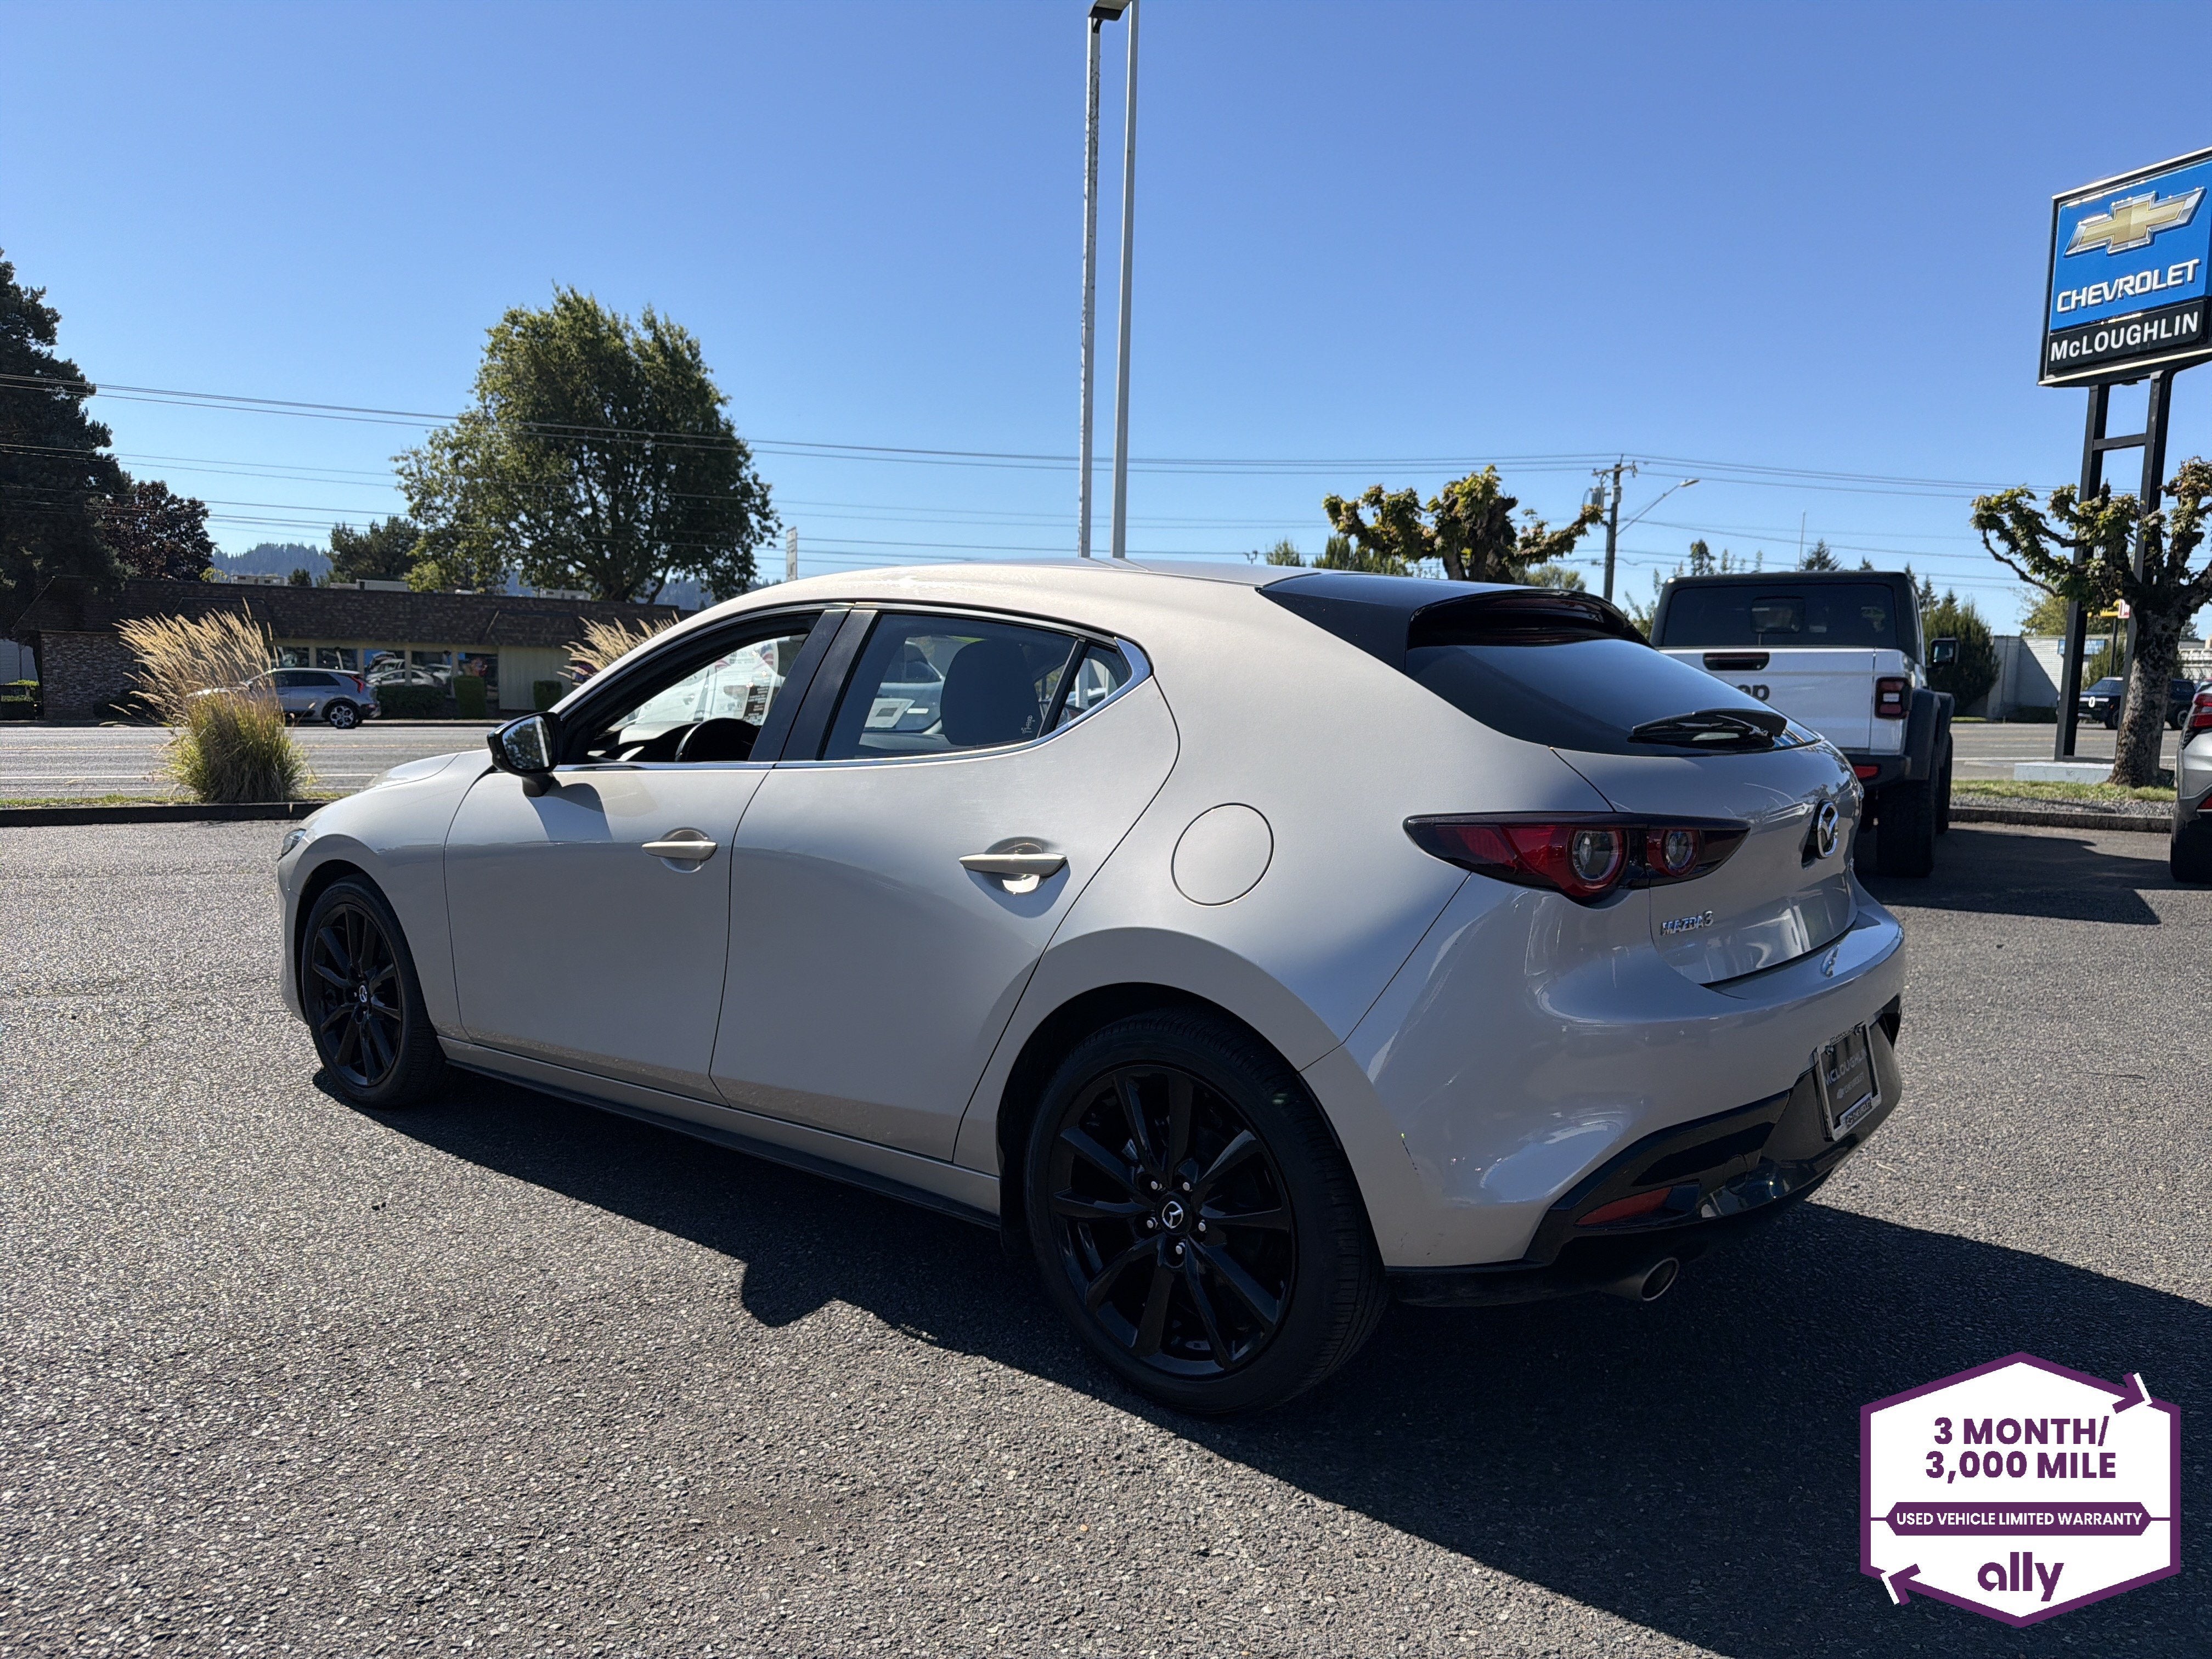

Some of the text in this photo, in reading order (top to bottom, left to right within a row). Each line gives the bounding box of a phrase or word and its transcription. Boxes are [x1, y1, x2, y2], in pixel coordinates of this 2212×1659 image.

[2056, 258, 2200, 313] CHEVROLET
[2050, 311, 2199, 362] McLOUGHLIN
[1661, 910, 1714, 935] MAZDA3
